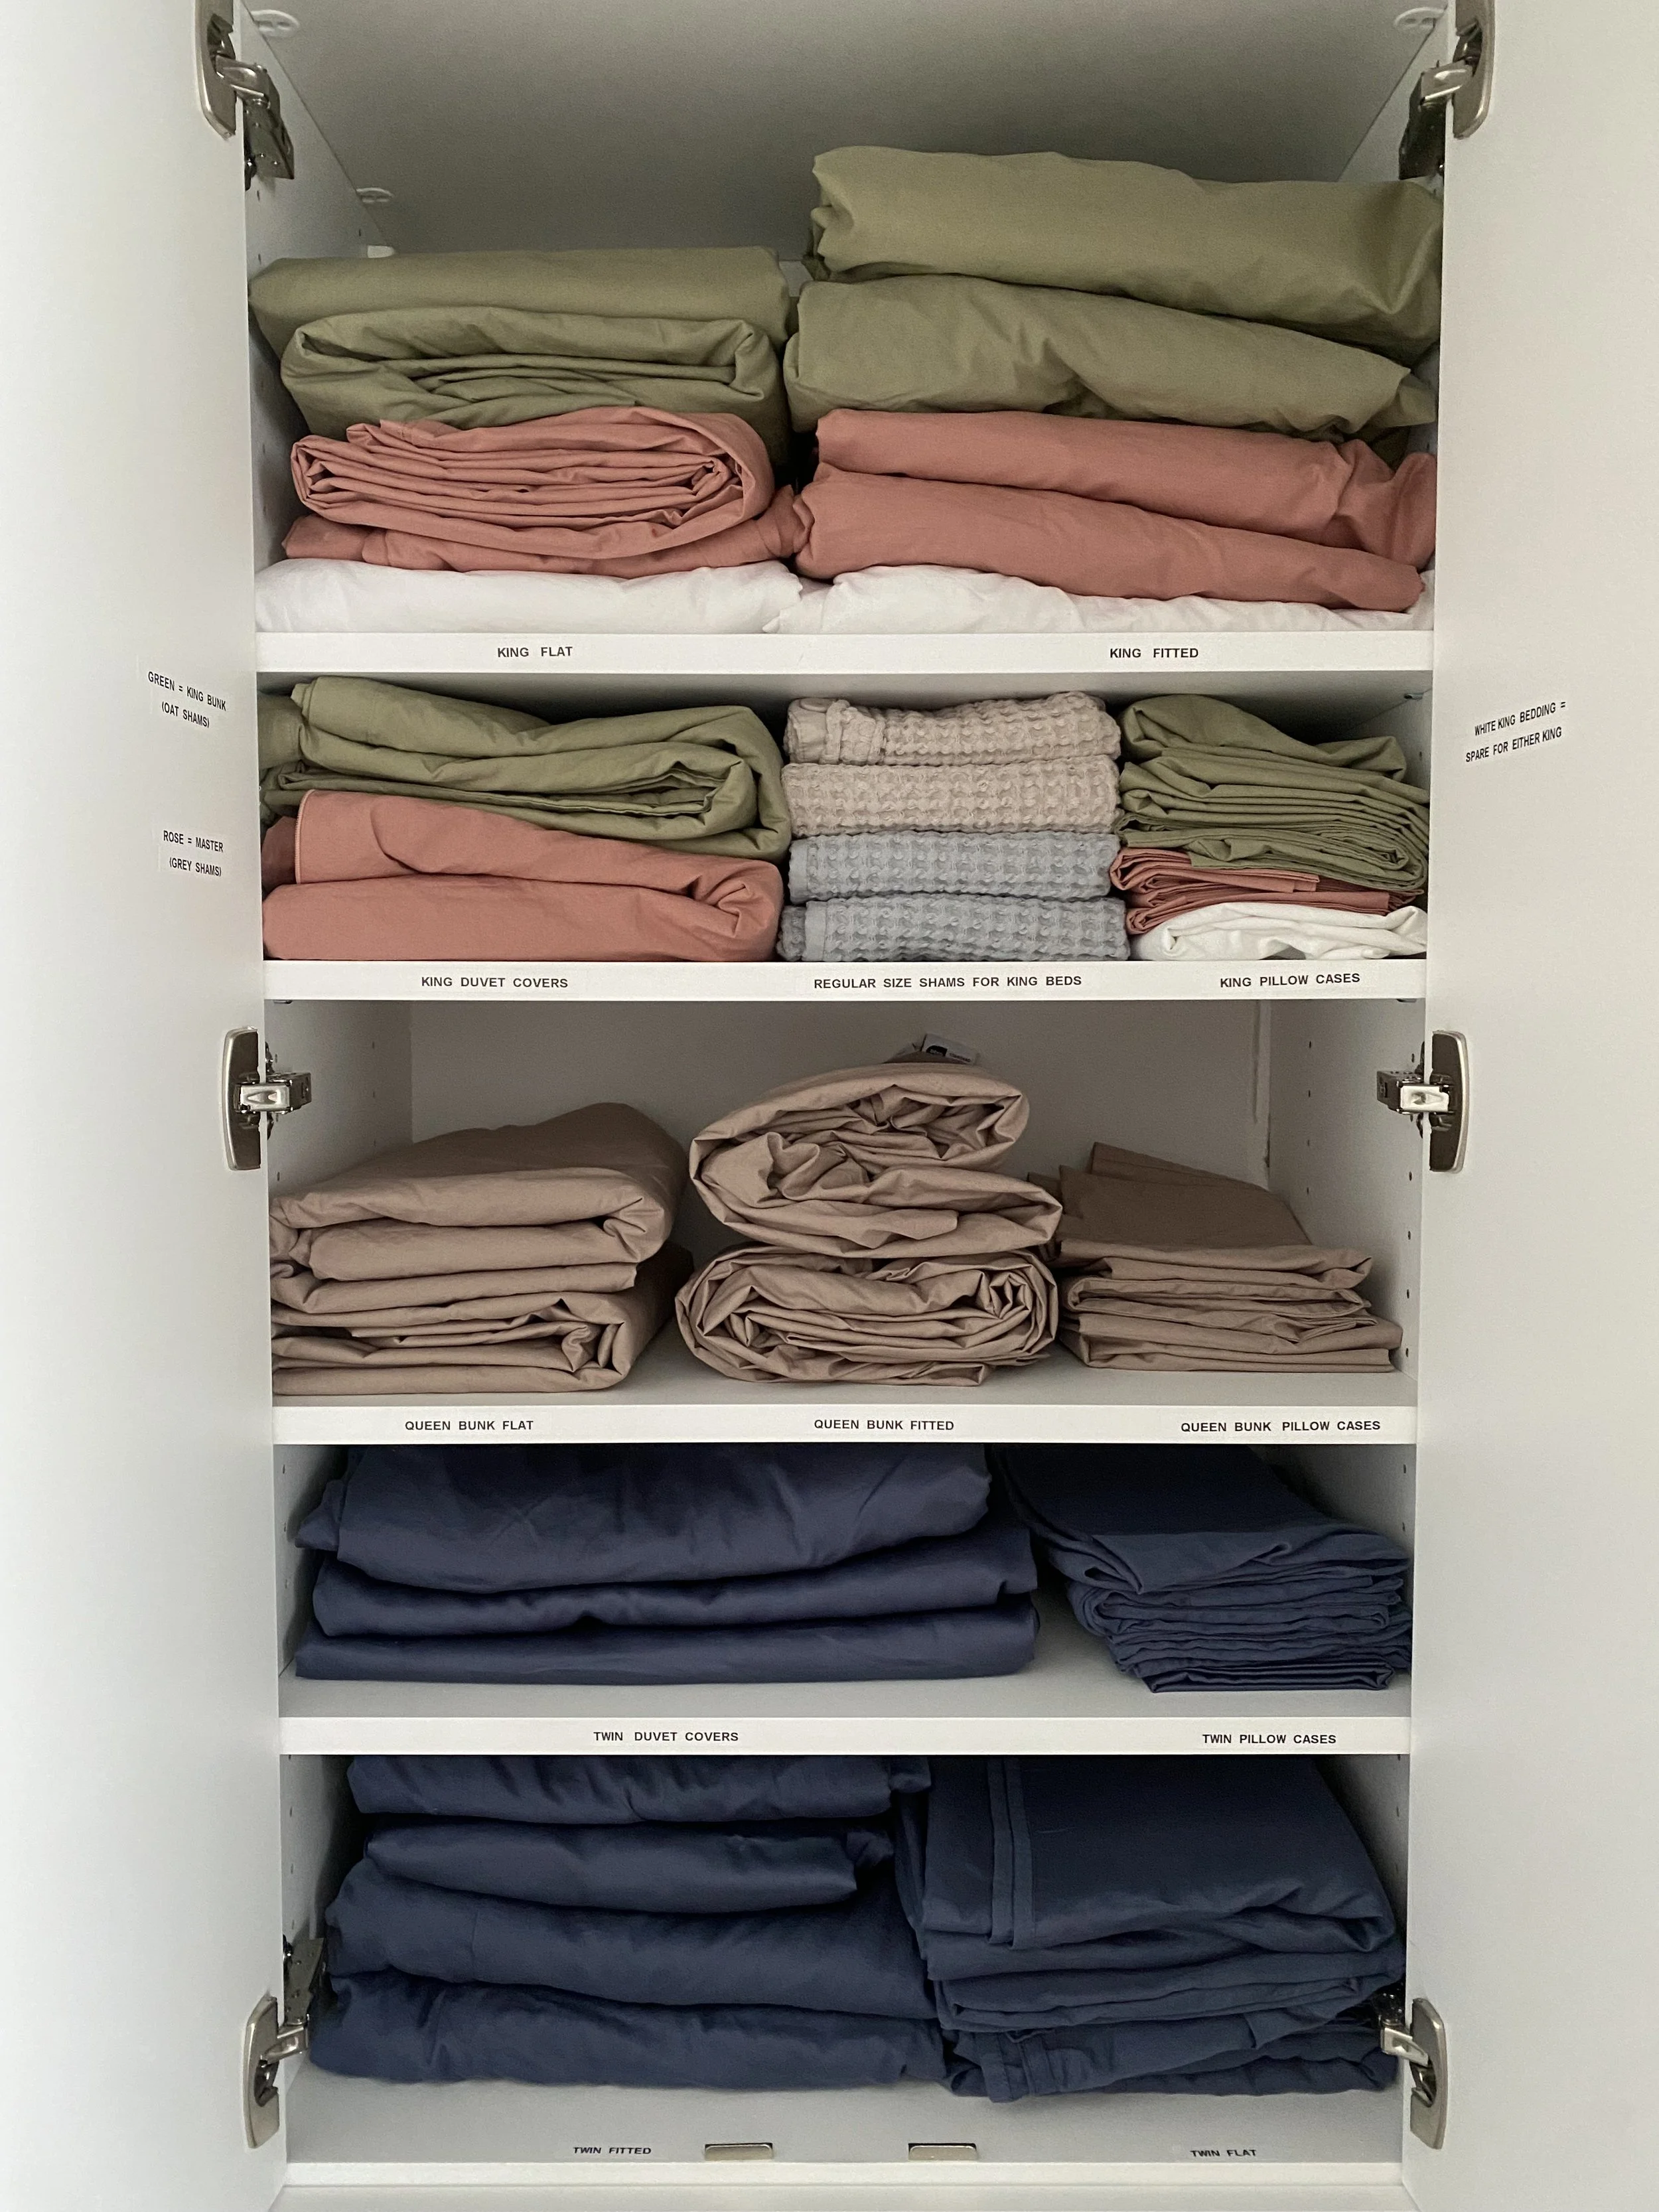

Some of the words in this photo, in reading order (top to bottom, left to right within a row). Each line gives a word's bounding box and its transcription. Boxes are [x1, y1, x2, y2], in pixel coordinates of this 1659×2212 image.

[497, 647, 529, 658] KING
[541, 646, 573, 657] FLAT
[1110, 648, 1141, 658] KING
[1153, 648, 1198, 658] FITTED
[148, 671, 175, 691] GREEN
[186, 686, 204, 701] KING
[207, 694, 226, 711] BUNK
[161, 701, 179, 717] (OAT
[182, 709, 210, 728] SHAMS)
[1475, 720, 1496, 736] WHITE
[1498, 715, 1516, 729] KING
[1520, 702, 1556, 723] BEDDING
[1466, 747, 1489, 763] SPARE
[1493, 741, 1508, 755] FOR
[1512, 732, 1540, 750] EITHER
[1542, 727, 1562, 742] KING
[163, 830, 184, 844] ROSE
[196, 837, 224, 853] MASTER
[169, 857, 192, 871] (GREY
[195, 862, 222, 877] SHAMS)
[421, 976, 453, 987] KING
[461, 977, 506, 988] DUVET
[513, 978, 568, 988] COVERS
[814, 978, 877, 989] REGULAR
[883, 978, 912, 988] SIZE
[919, 977, 965, 988] SHAMS
[973, 977, 999, 987] FOR
[1007, 976, 1038, 987] KING
[1046, 976, 1082, 986] BEDS
[1220, 977, 1252, 988] KING
[1260, 975, 1309, 987] PILLOW
[1316, 973, 1360, 984] CASES
[405, 1421, 451, 1431] QUEEN
[459, 1420, 496, 1430] BUNK
[502, 1420, 534, 1430] FLAT
[814, 1419, 859, 1430] QUEEN
[867, 1420, 903, 1430] BUNK
[910, 1420, 954, 1430] FITTED
[1181, 1422, 1227, 1432] QUEEN
[1234, 1422, 1271, 1432] BUNK
[1282, 1421, 1330, 1432] PILLOW
[1336, 1420, 1381, 1431] CASES
[593, 1732, 623, 1741] TWIN
[634, 1732, 678, 1741] DUVET
[685, 1732, 739, 1741] COVERS
[1202, 1734, 1232, 1744] TWIN
[1240, 1734, 1287, 1744] PILLOW
[1293, 1734, 1336, 1744] CASES
[573, 2146, 603, 2155] TWIN
[608, 2146, 652, 2155] FITTED
[1190, 2149, 1221, 2158] TWIN
[1226, 2148, 1258, 2158] FLAT
